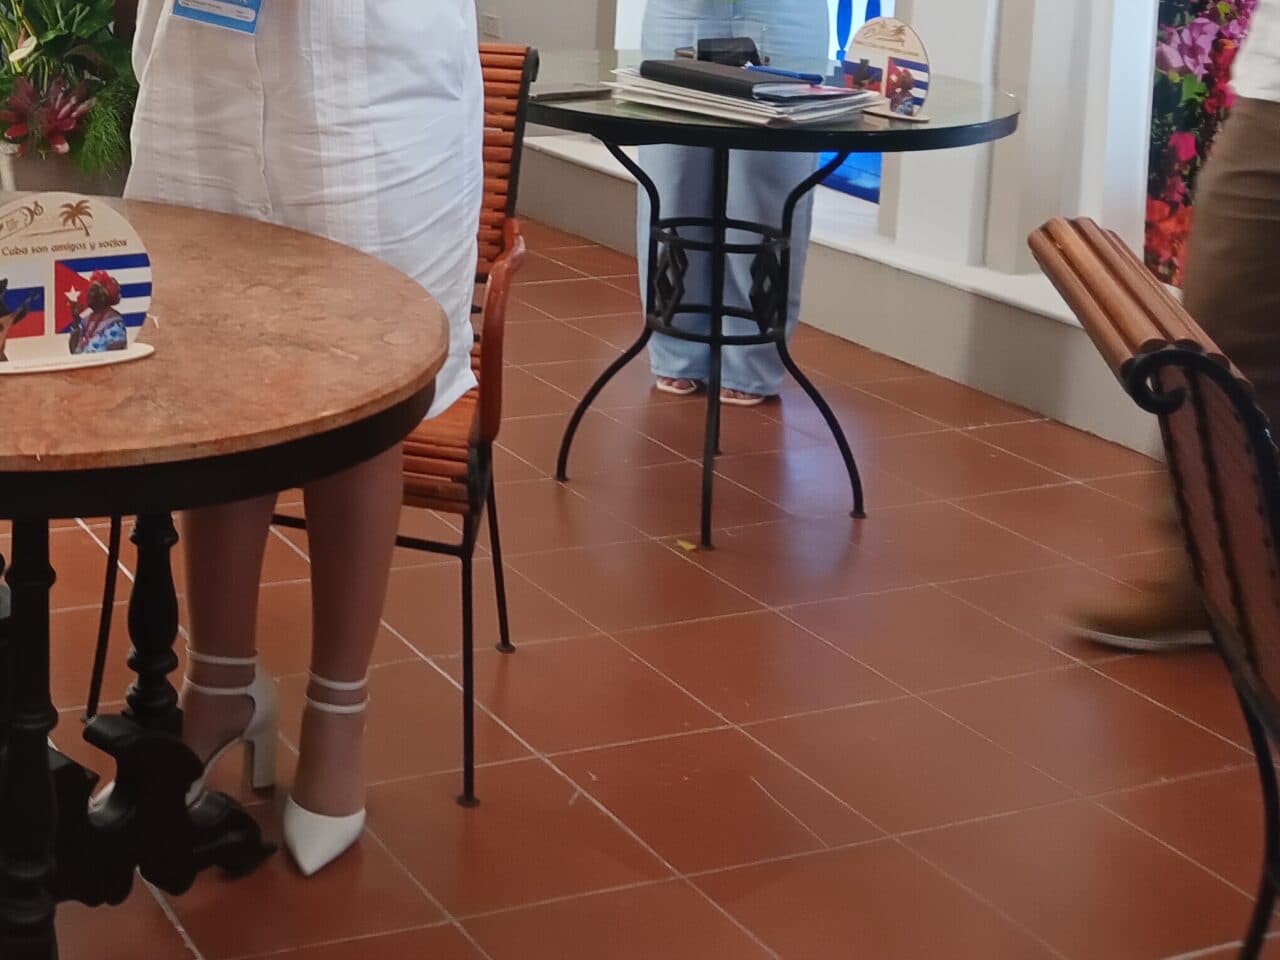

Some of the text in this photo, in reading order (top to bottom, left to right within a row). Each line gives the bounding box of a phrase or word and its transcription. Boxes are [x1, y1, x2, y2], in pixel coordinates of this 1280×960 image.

[1, 246, 28, 257] Cuba
[31, 245, 49, 255] son
[51, 242, 87, 254] amigos
[89, 242, 96, 251] y
